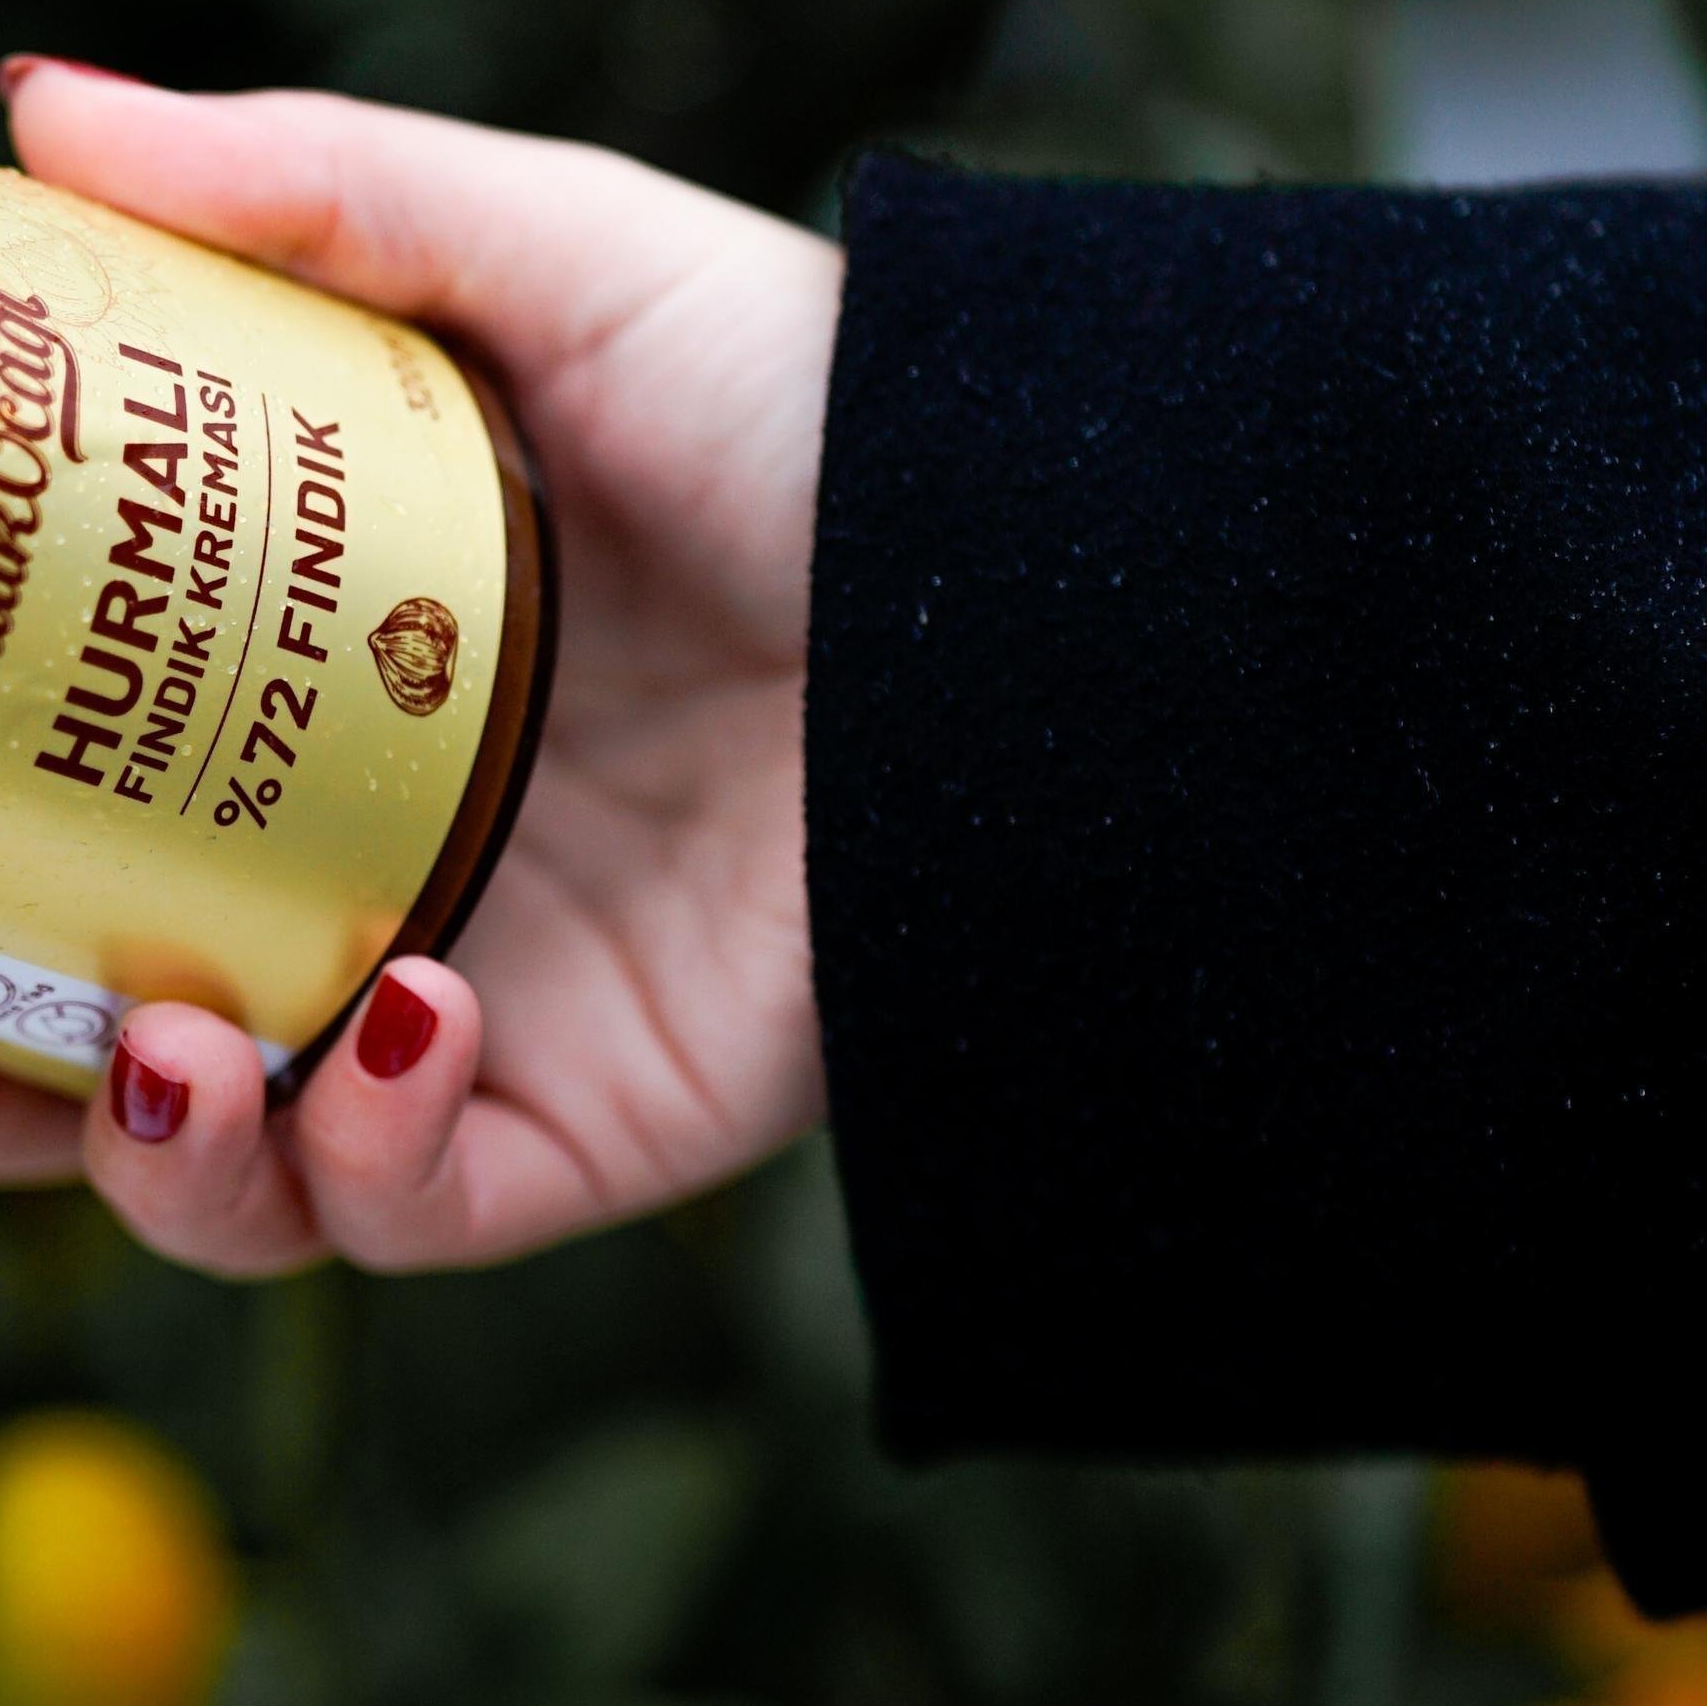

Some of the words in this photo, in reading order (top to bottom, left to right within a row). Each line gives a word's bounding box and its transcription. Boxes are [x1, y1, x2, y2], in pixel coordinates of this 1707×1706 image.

[33, 342, 189, 787] HURMALI
[112, 616, 217, 805] FINDIK
[184, 369, 240, 611] KREMASI
[213, 677, 319, 831] %72
[276, 405, 347, 664] FINDIK
